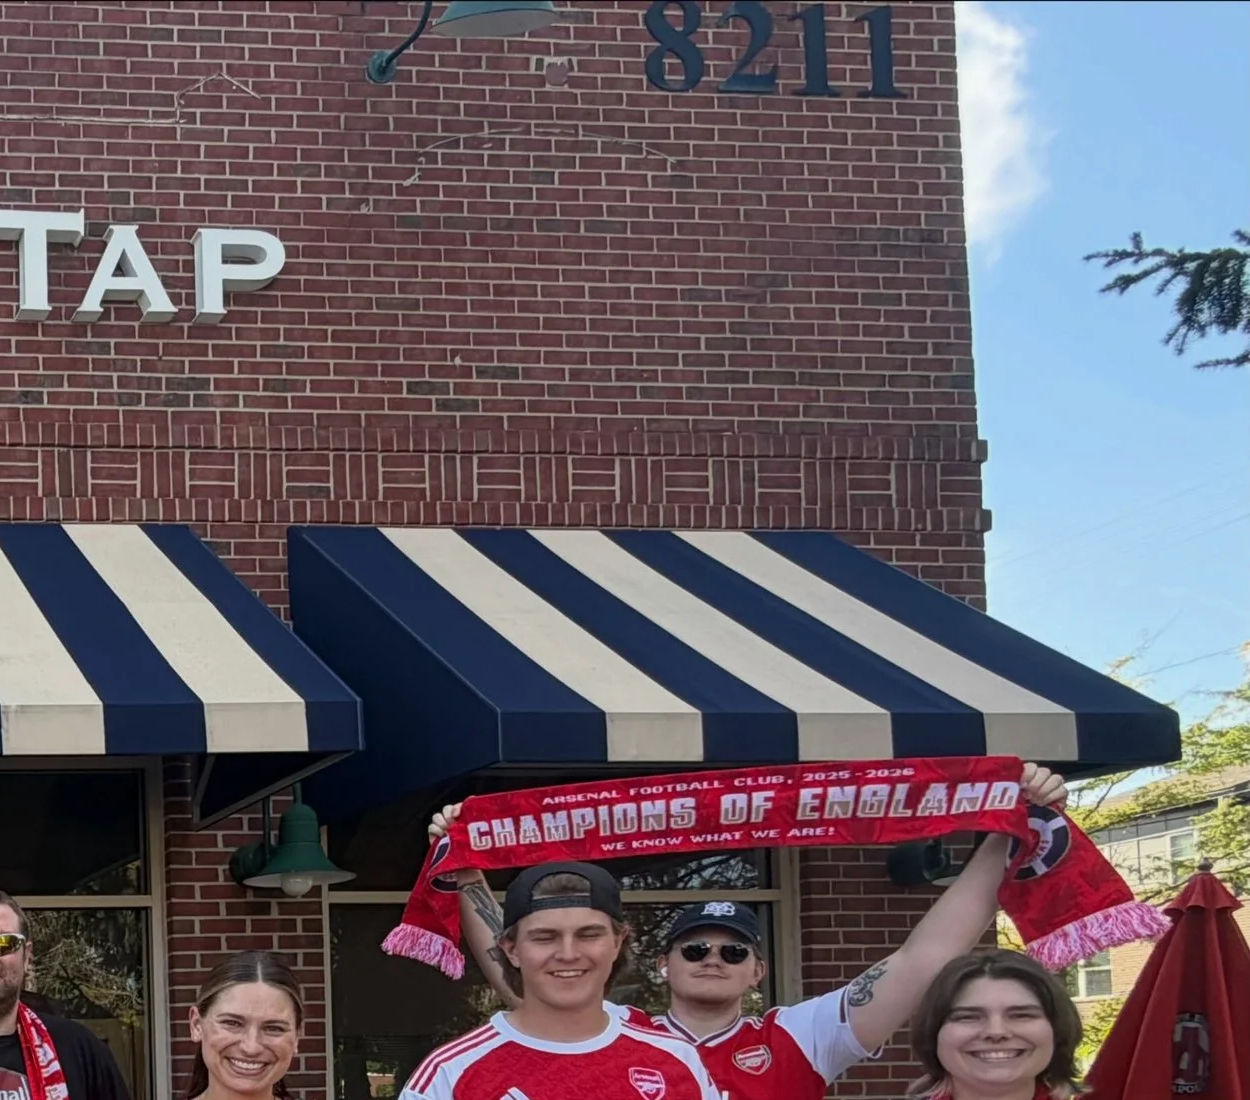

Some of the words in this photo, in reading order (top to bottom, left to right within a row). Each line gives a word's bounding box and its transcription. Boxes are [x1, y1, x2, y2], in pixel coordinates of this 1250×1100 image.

[644, 0, 908, 98] 8211
[542, 789, 621, 805] ARSENAL
[629, 780, 725, 797] FOOTBALL
[734, 774, 794, 788] CLUB,
[468, 797, 696, 850] CHAMPIONS
[720, 790, 775, 825] OF
[796, 781, 1021, 820] ENGLAND
[600, 840, 626, 851] WE
[632, 836, 683, 849] KNOW
[690, 830, 742, 843] WHAT
[751, 829, 780, 839] WE
[787, 826, 835, 837] ARE!
